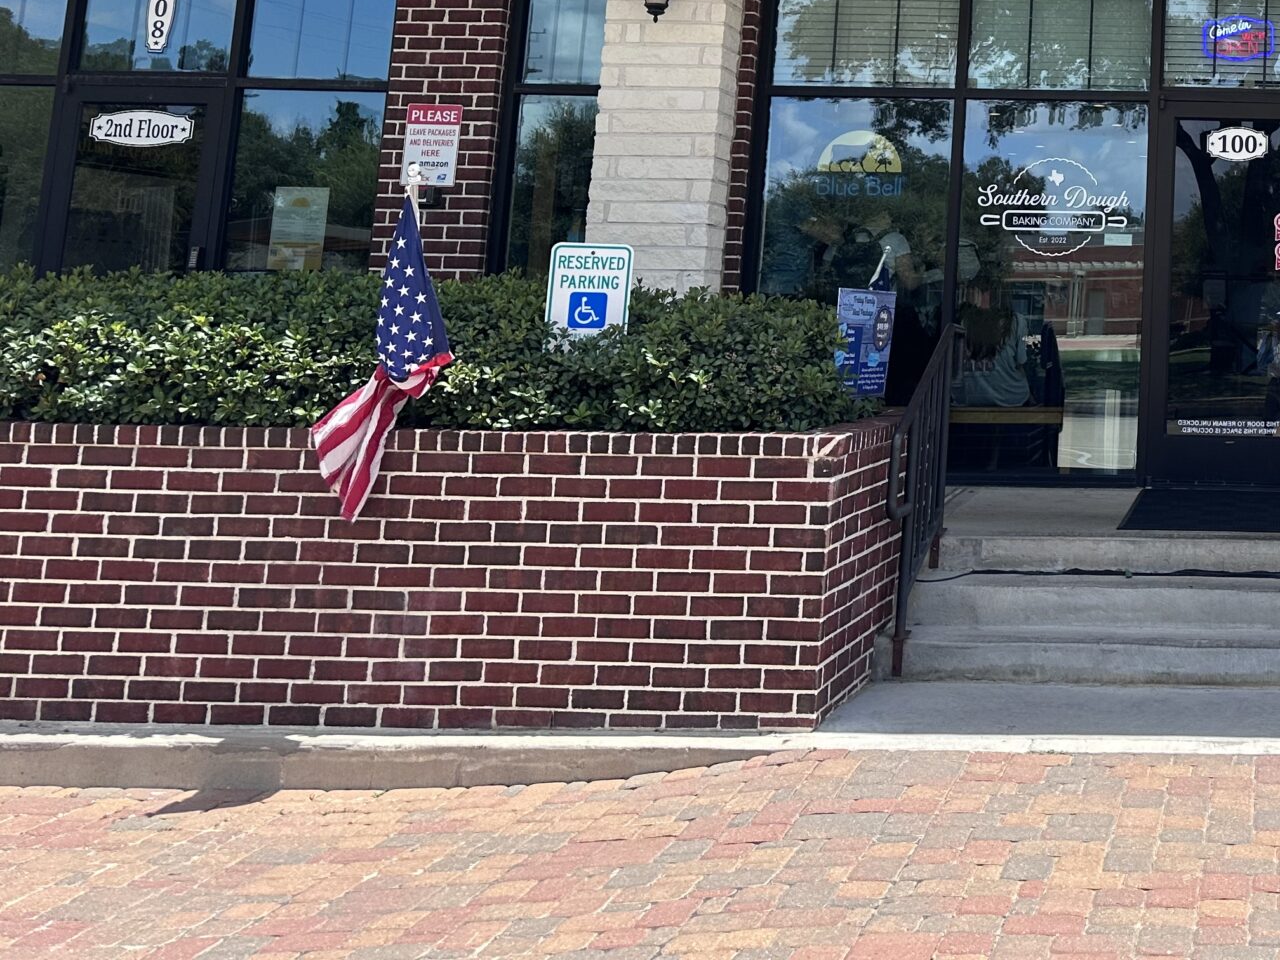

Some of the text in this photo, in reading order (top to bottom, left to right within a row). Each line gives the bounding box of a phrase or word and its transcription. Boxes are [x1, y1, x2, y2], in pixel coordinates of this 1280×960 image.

[411, 109, 458, 123] PLEASE
[104, 118, 179, 139] 2nd Floor
[409, 128, 456, 137] LEAVE PACKAGES
[409, 138, 454, 147] AND DELIVERIES
[1218, 134, 1257, 153] 100
[421, 149, 440, 157] HERE
[816, 175, 902, 197] Blue Bell
[977, 184, 1130, 214] Southern Dough
[1012, 215, 1096, 227] BAKING COMPANY
[1051, 236, 1067, 244] 2022
[558, 255, 626, 271] RESERVED
[560, 274, 620, 290] PARKING
